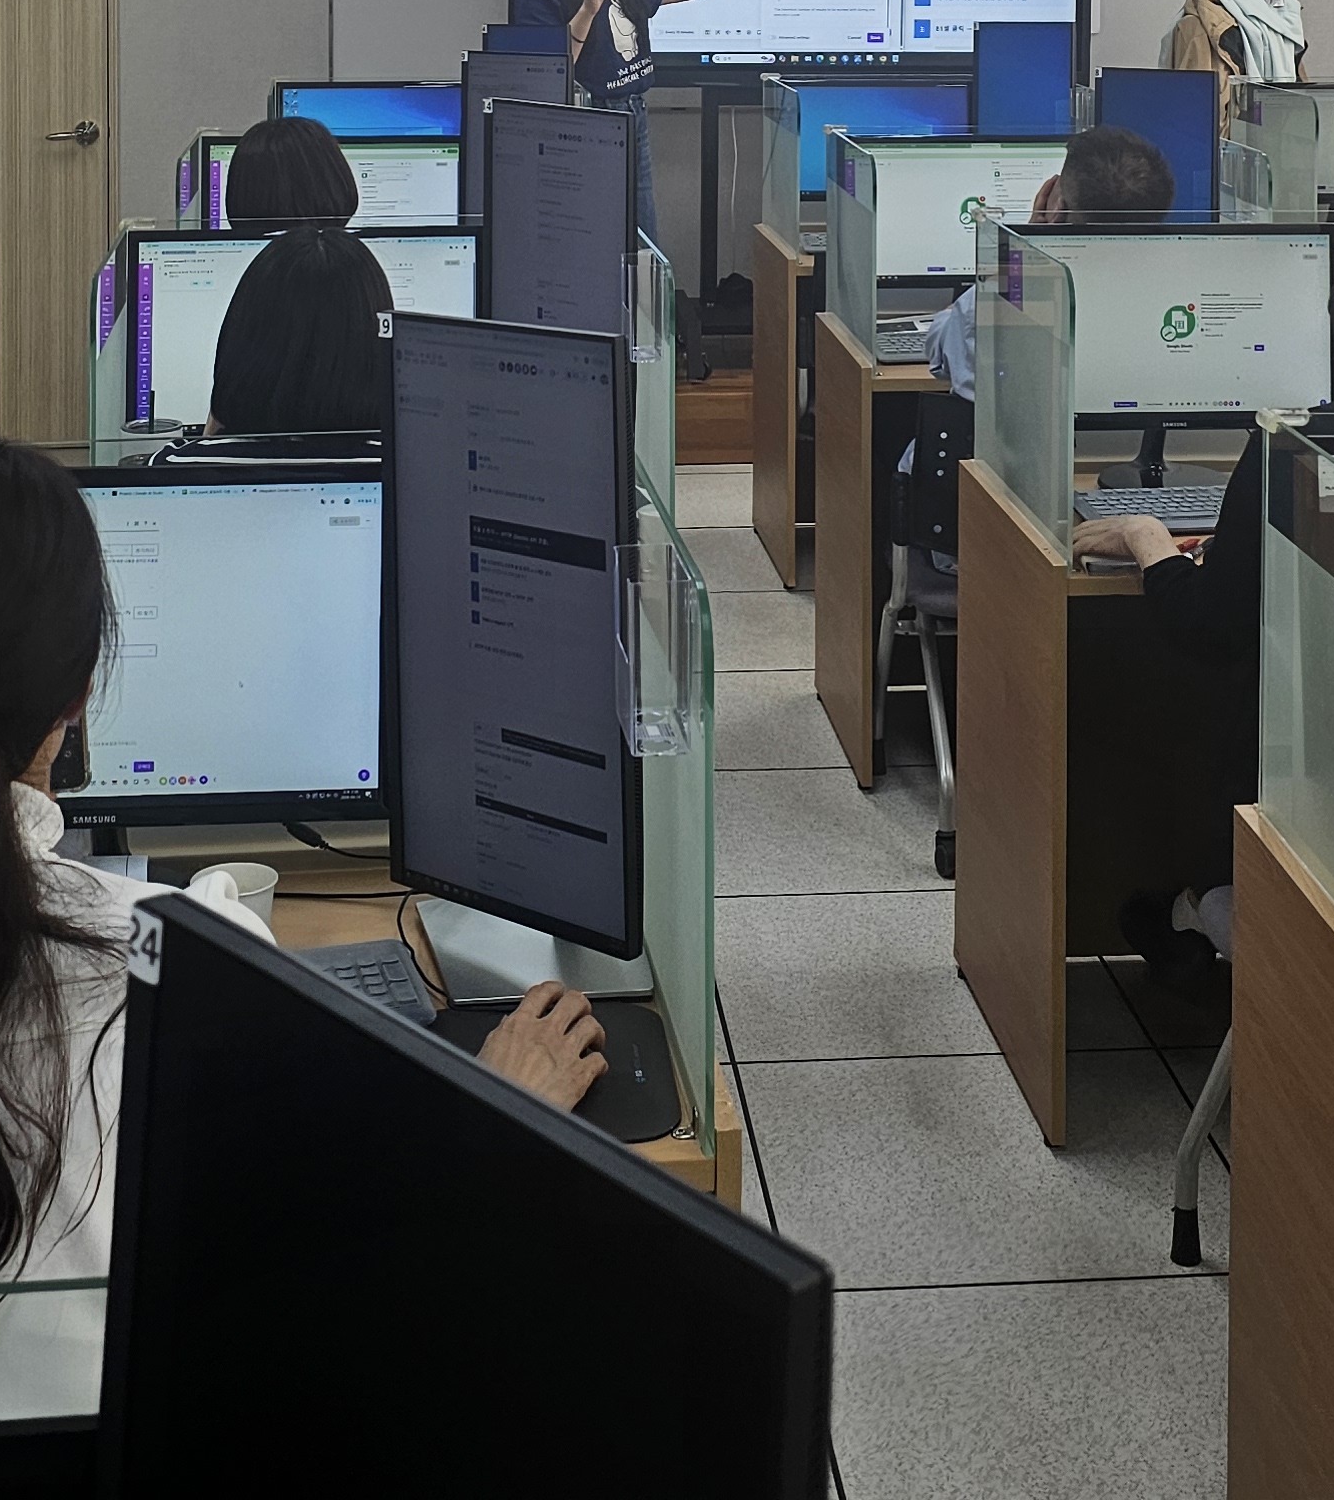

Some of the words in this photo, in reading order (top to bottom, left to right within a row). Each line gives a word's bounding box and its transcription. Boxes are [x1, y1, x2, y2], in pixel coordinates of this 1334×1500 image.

[485, 101, 492, 111] 4
[382, 319, 390, 334] 9
[72, 815, 116, 824] SAMSUNG
[130, 914, 159, 965] 24
